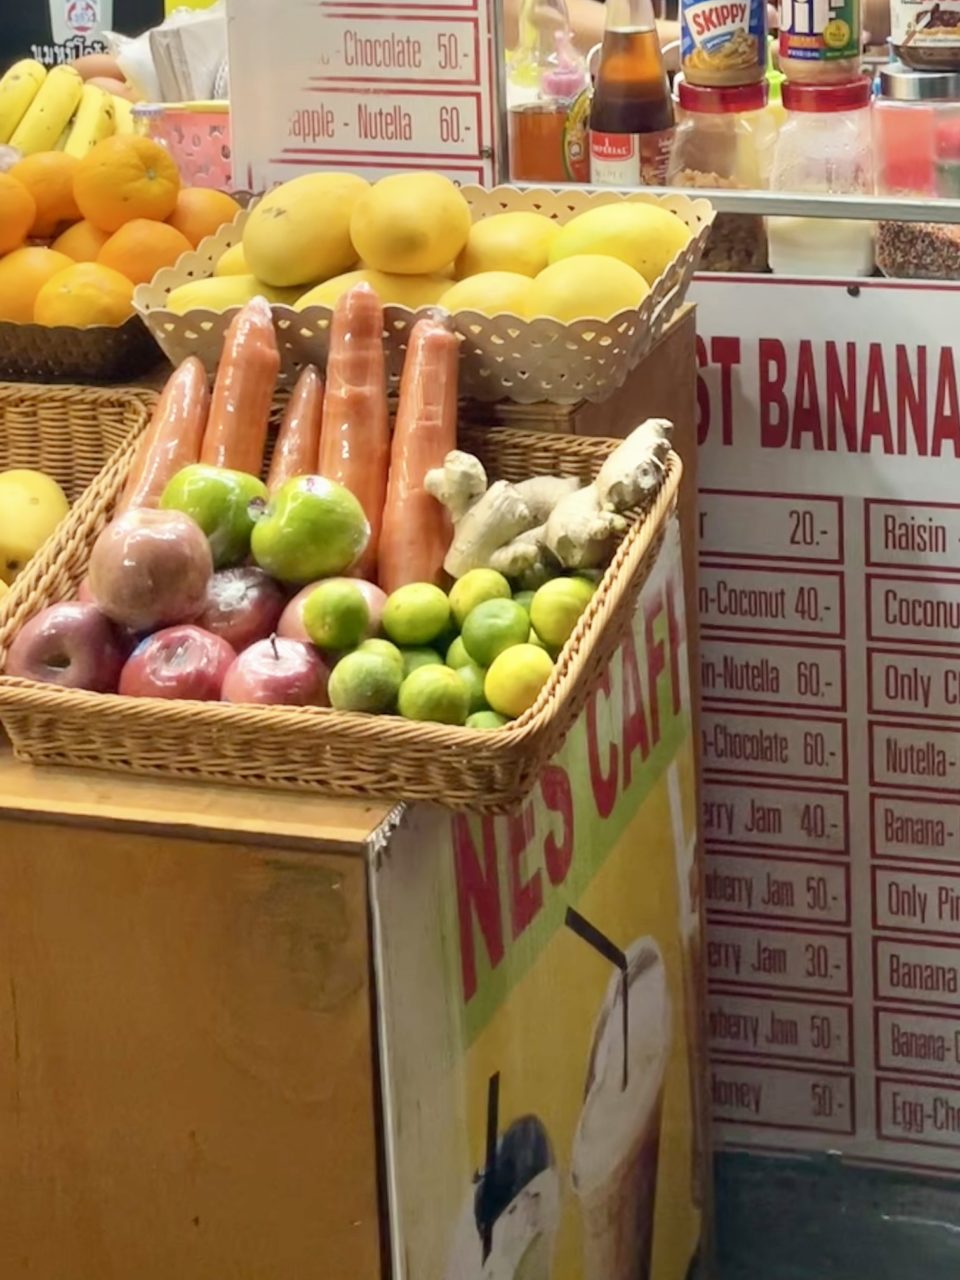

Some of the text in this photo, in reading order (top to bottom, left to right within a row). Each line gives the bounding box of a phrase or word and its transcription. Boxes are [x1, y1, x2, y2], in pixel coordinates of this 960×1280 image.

[692, 3, 748, 36] SKIPPY
[437, 33, 469, 70] 50.-
[358, 103, 412, 141] Nutella
[440, 106, 471, 143] 60.-
[789, 510, 828, 547] 20.-
[883, 514, 947, 553] Raisin
[794, 586, 832, 622] 40.-
[797, 661, 833, 698] 60.-
[885, 665, 932, 709] Only
[803, 731, 837, 768] 60.-
[744, 798, 783, 834] Jam
[800, 804, 839, 840] 40.-
[761, 872, 795, 908] Jam
[887, 881, 928, 924] Only
[751, 938, 787, 974] Jam
[805, 943, 842, 980] 30.-
[889, 953, 958, 993] Banana
[765, 1010, 799, 1046] Jam
